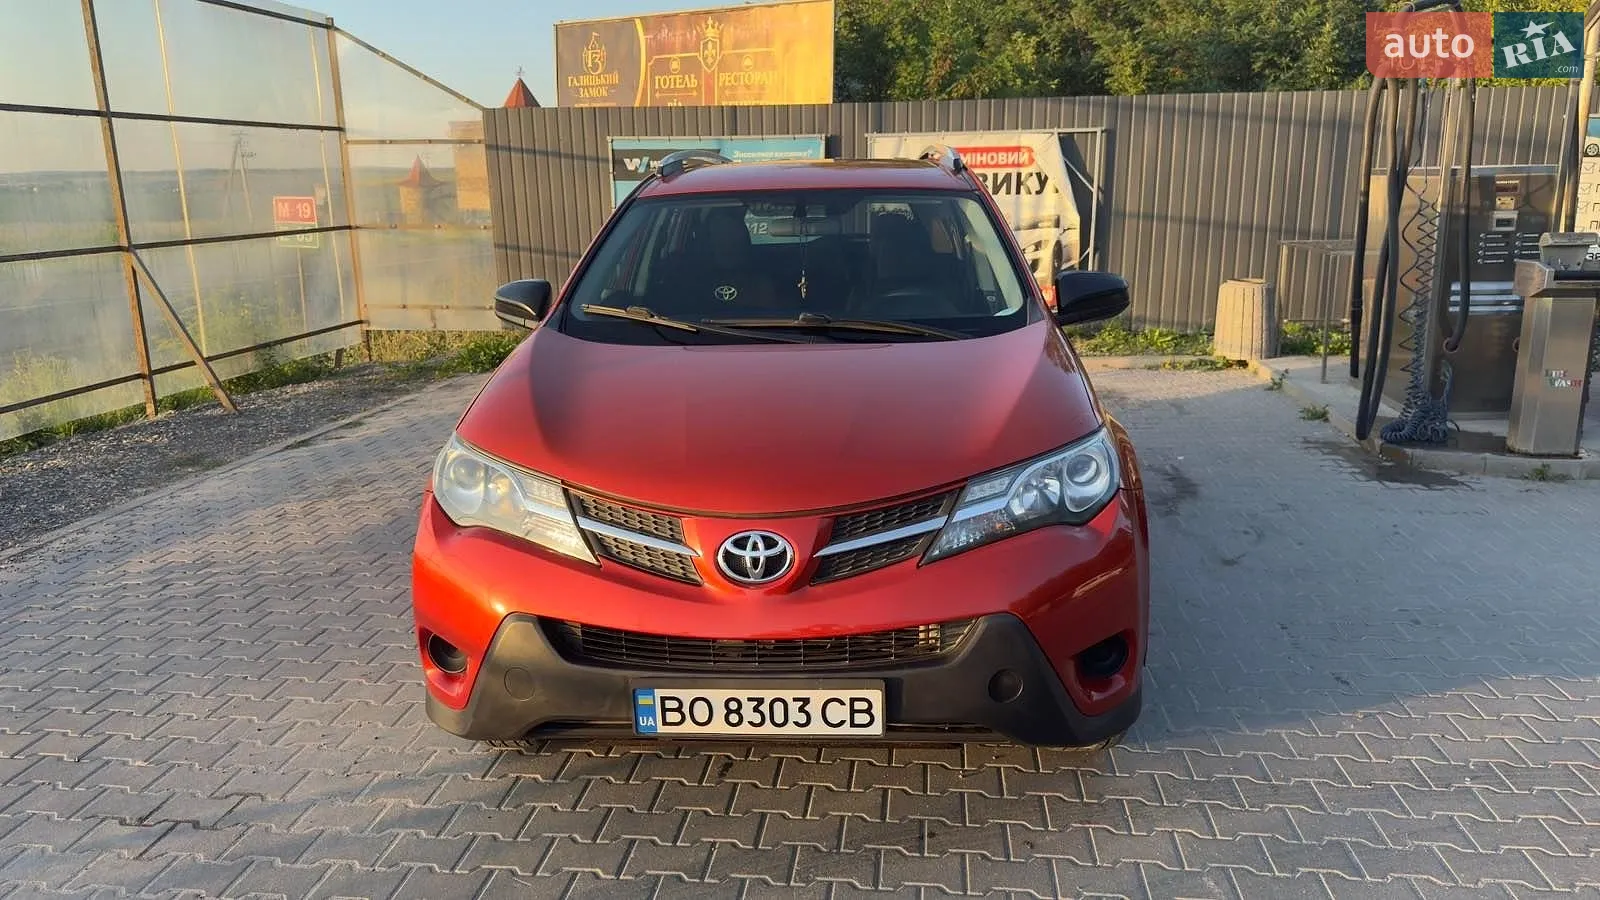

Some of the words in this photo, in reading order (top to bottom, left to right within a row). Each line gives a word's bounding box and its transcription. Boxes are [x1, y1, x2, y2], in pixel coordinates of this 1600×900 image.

[655, 74, 698, 89] ГОТЕЛЬ
[578, 86, 609, 98] ЗАМОК
[959, 150, 1029, 166] МІНОВИЙ
[975, 171, 1059, 196] ВИКУ
[659, 695, 714, 727] BO
[723, 696, 812, 728] 8303
[820, 697, 876, 728] CB
[639, 717, 655, 726] UA
